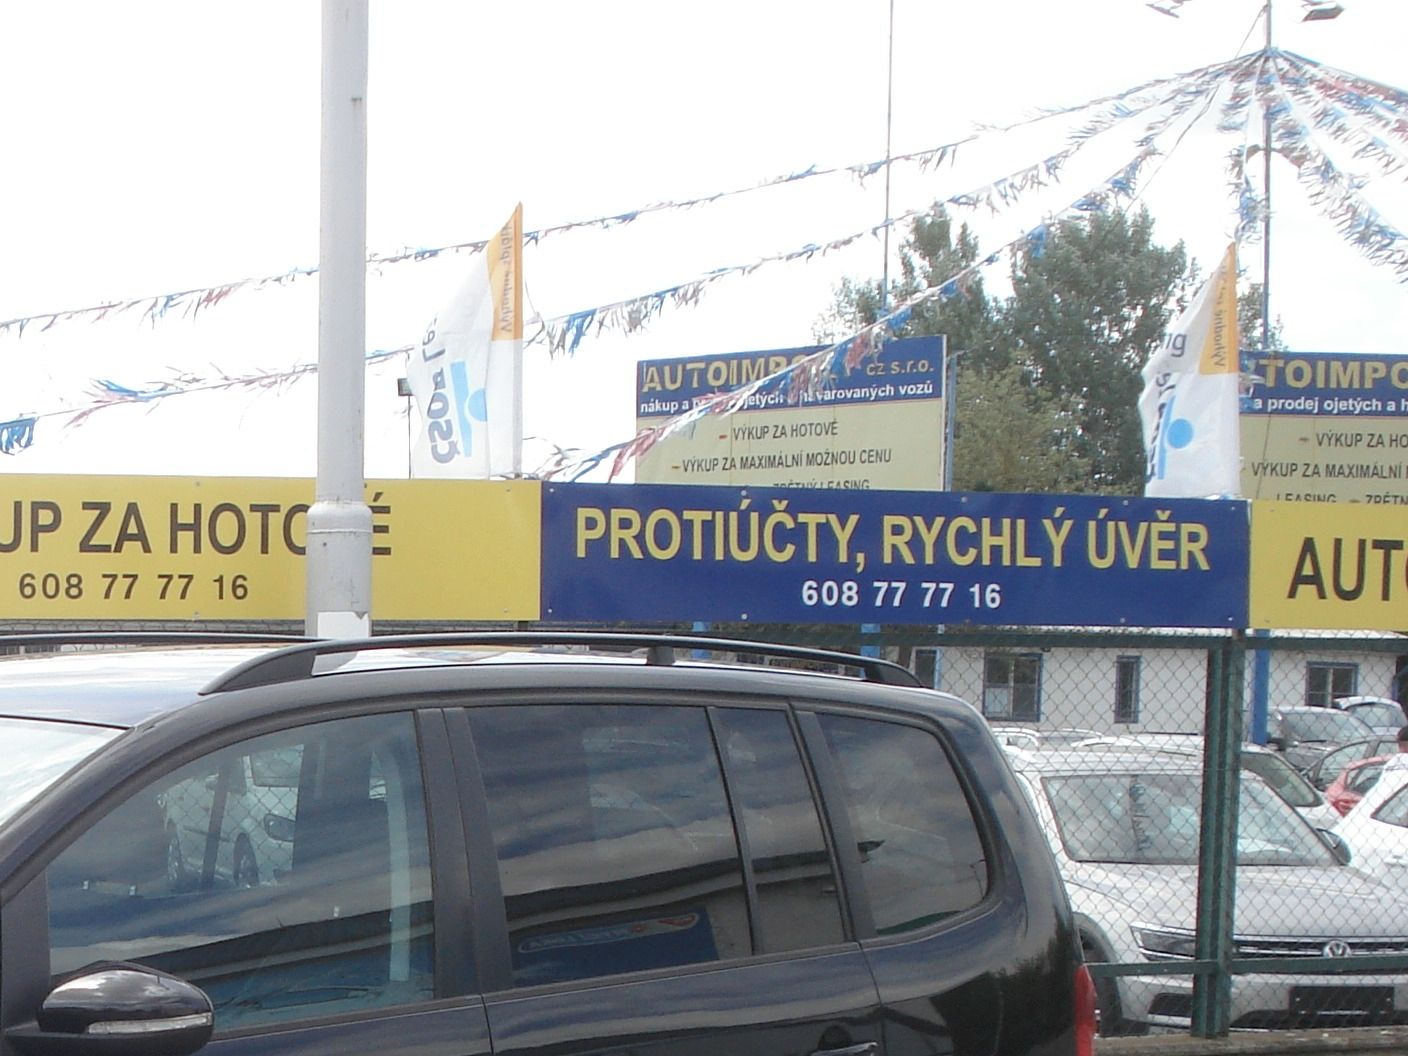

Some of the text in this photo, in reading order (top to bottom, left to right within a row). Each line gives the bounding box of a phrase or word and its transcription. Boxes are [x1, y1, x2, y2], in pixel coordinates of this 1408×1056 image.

[640, 398, 679, 414] nákup
[899, 380, 934, 396] vozů
[1267, 396, 1320, 414] prodej
[1323, 396, 1382, 414] ojetých
[1386, 399, 1396, 411] a
[733, 418, 839, 441] VÝKUP ZA HOTOVÉ
[1316, 429, 1363, 448] VÝKUP
[1366, 433, 1385, 448] ZA
[682, 448, 892, 473] VÝKUP ZA MAXIMÁLNÍ MOŽNOU CENU
[1251, 461, 1299, 478] VÝKUP
[1301, 462, 1322, 479] ZA
[1324, 460, 1404, 480] MAXIMÁLNÍ
[78, 501, 153, 554] ZA
[169, 491, 392, 556] HOTOÉ
[575, 498, 1211, 574] PROTIÚČTY, RYCHLÝ ÚVĚR
[1286, 536, 1408, 602] AUT
[18, 572, 249, 600] 608 77 77 16
[801, 580, 1002, 609] 608 77 77 16
